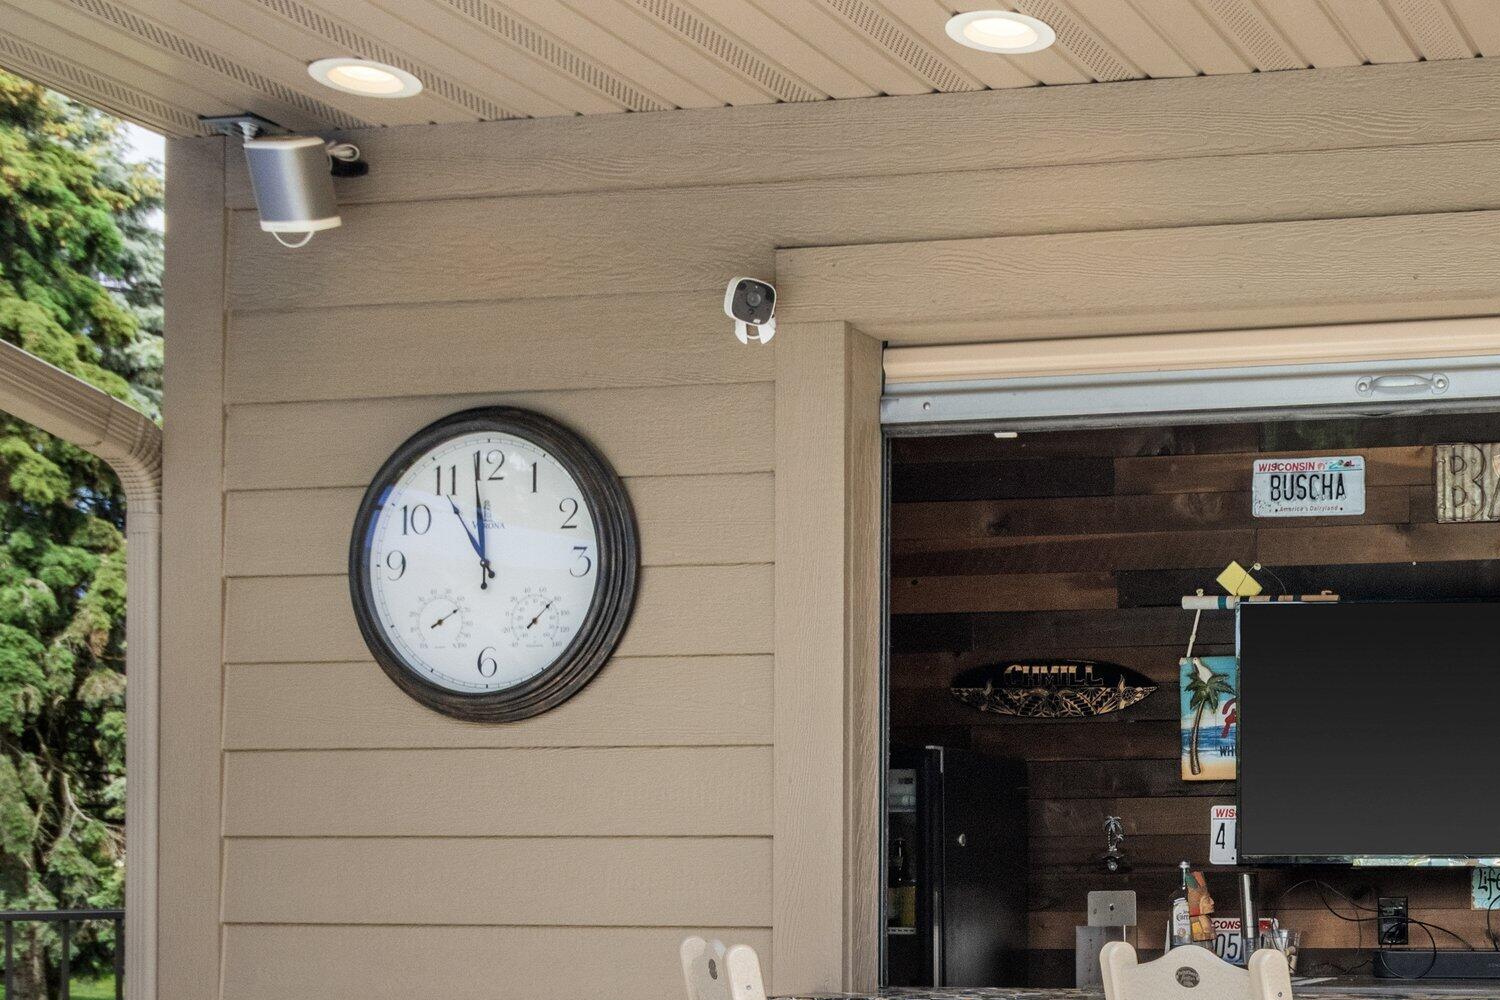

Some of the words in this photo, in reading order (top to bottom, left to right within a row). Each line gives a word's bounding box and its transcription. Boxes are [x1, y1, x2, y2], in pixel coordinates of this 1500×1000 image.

[435, 464, 458, 496] 11
[474, 449, 505, 481] 12
[530, 462, 538, 493] 1
[1259, 462, 1316, 472] WISCONSIN
[1270, 473, 1347, 501] BUSCHA
[400, 503, 432, 536] 10
[558, 497, 579, 529] 2
[1309, 505, 1339, 513] Dairyland
[386, 550, 407, 581] 9
[569, 546, 592, 578] 3
[477, 646, 498, 678] 6
[1216, 808, 1237, 818] WIS
